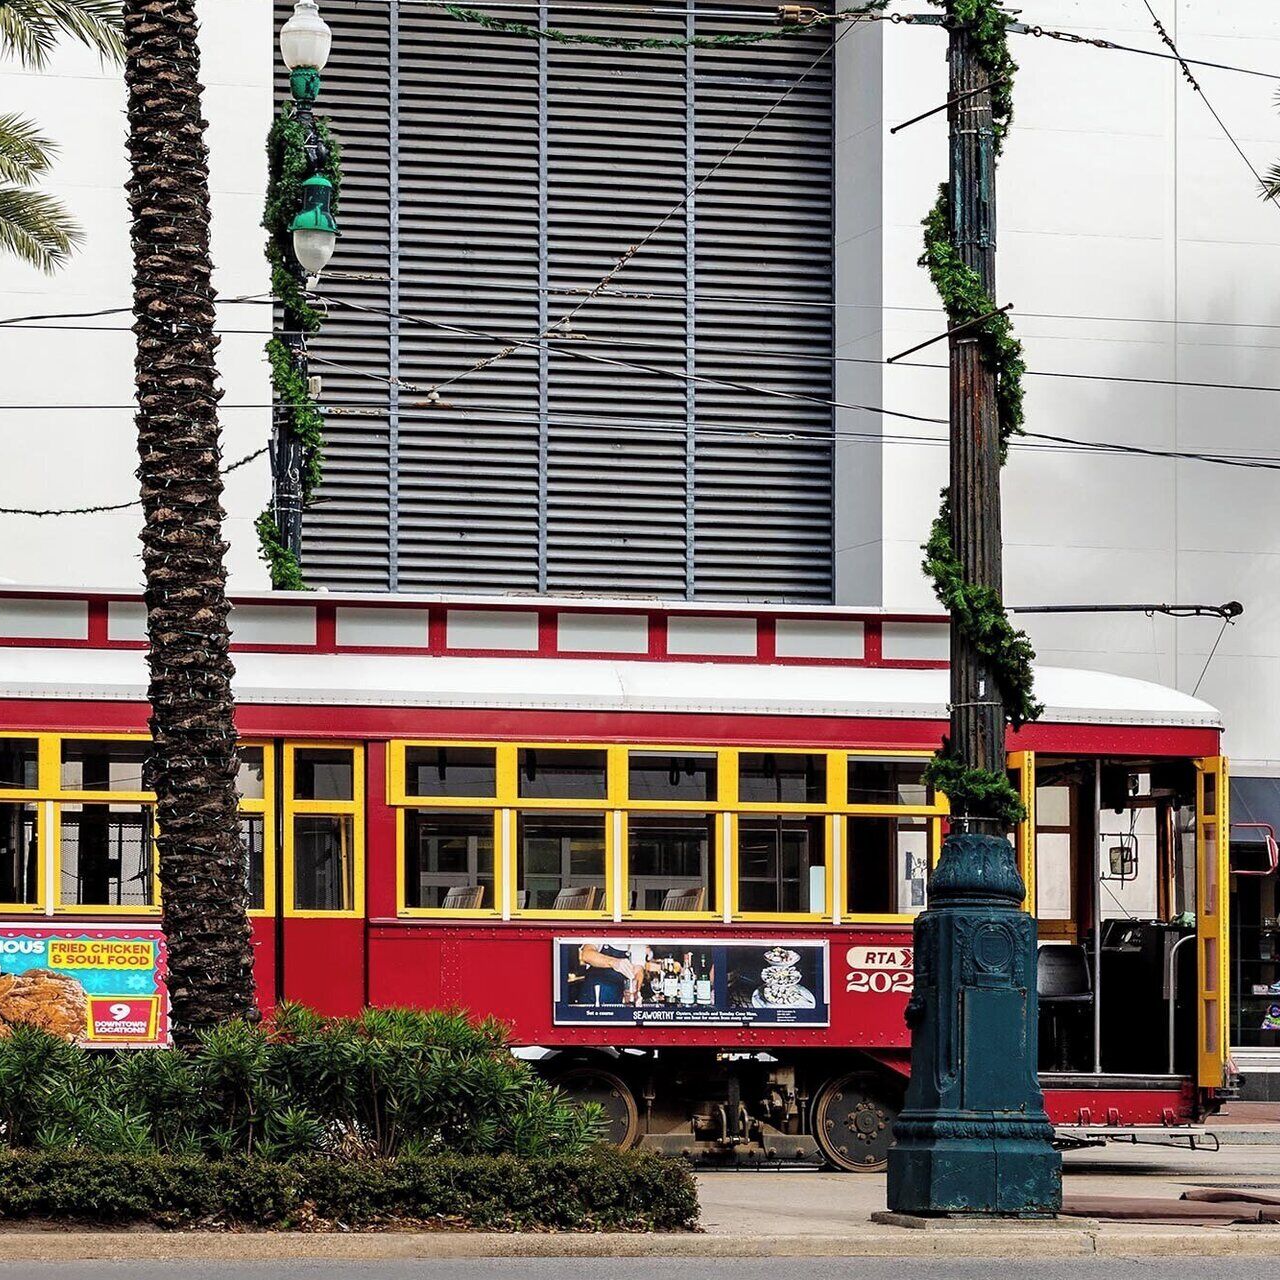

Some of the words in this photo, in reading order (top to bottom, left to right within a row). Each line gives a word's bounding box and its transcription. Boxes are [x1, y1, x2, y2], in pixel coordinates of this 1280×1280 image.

[51, 943, 88, 953] FRIED
[91, 944, 151, 954] CHICKEN
[52, 955, 62, 964] &
[66, 955, 104, 965] SOUL
[108, 955, 150, 966] FOOD
[865, 952, 897, 964] RTA
[846, 971, 914, 993] 202
[109, 1003, 131, 1021] 9
[633, 1011, 675, 1020] SEAWORTHY
